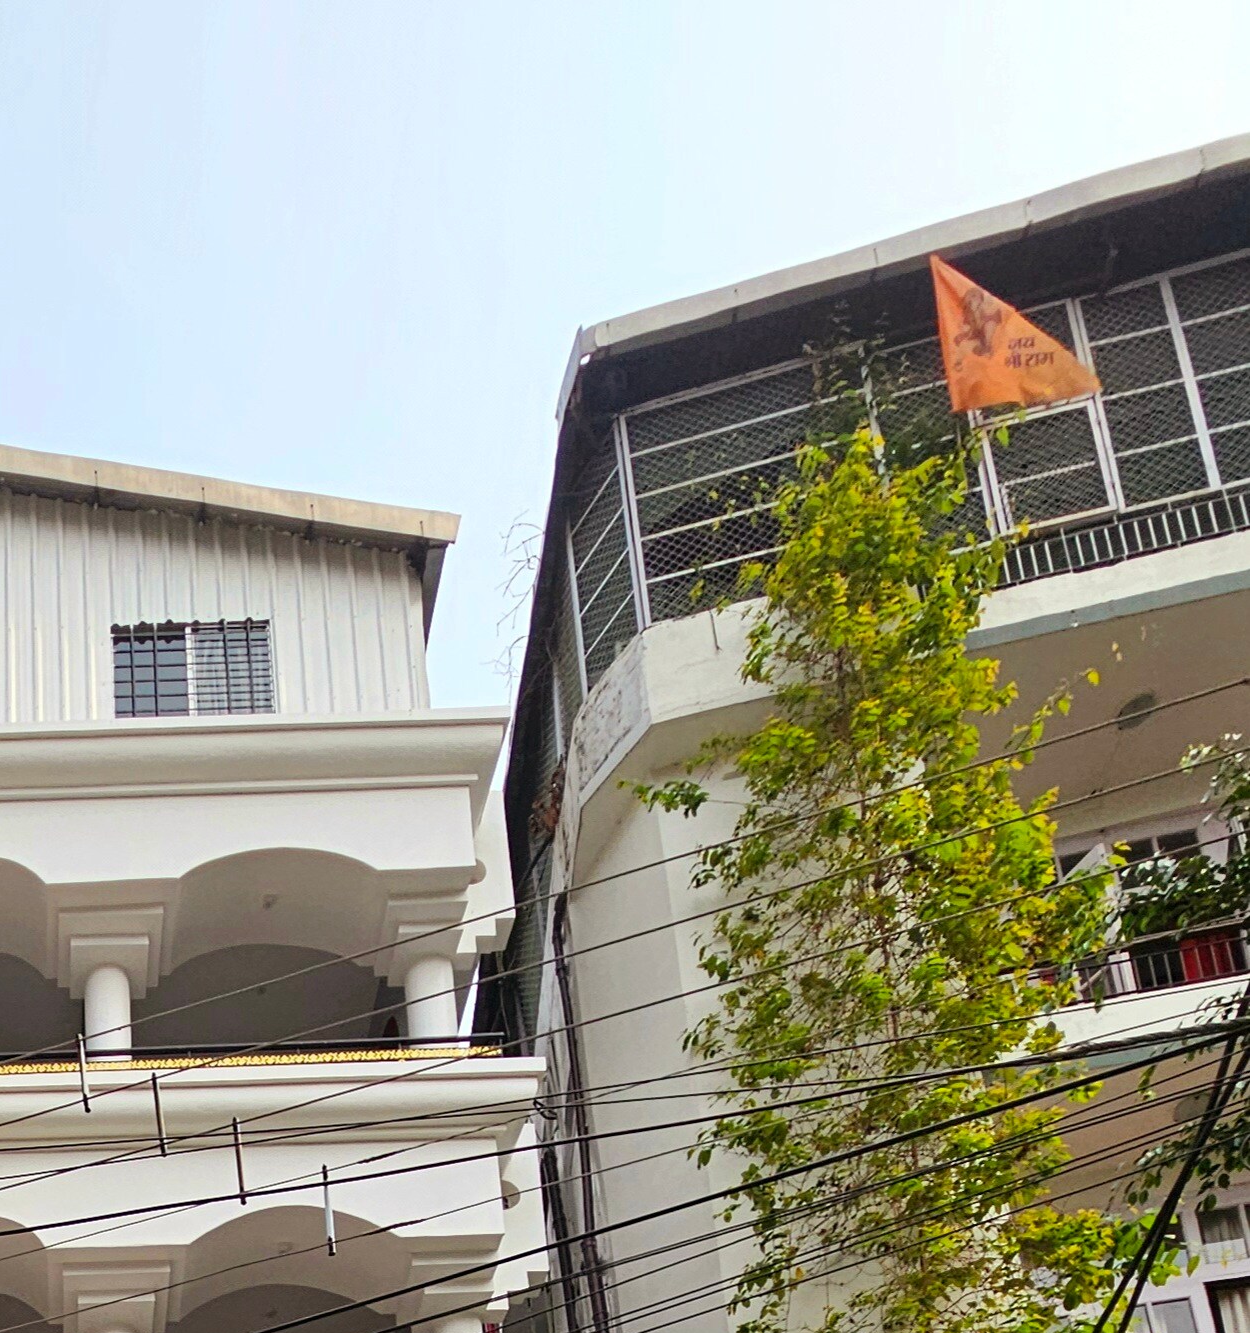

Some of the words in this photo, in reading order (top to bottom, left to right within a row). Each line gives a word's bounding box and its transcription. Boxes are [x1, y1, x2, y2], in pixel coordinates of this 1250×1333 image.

[1008, 335, 1035, 350] जय
[1004, 350, 1022, 369] श्री
[1025, 351, 1054, 367] राम
